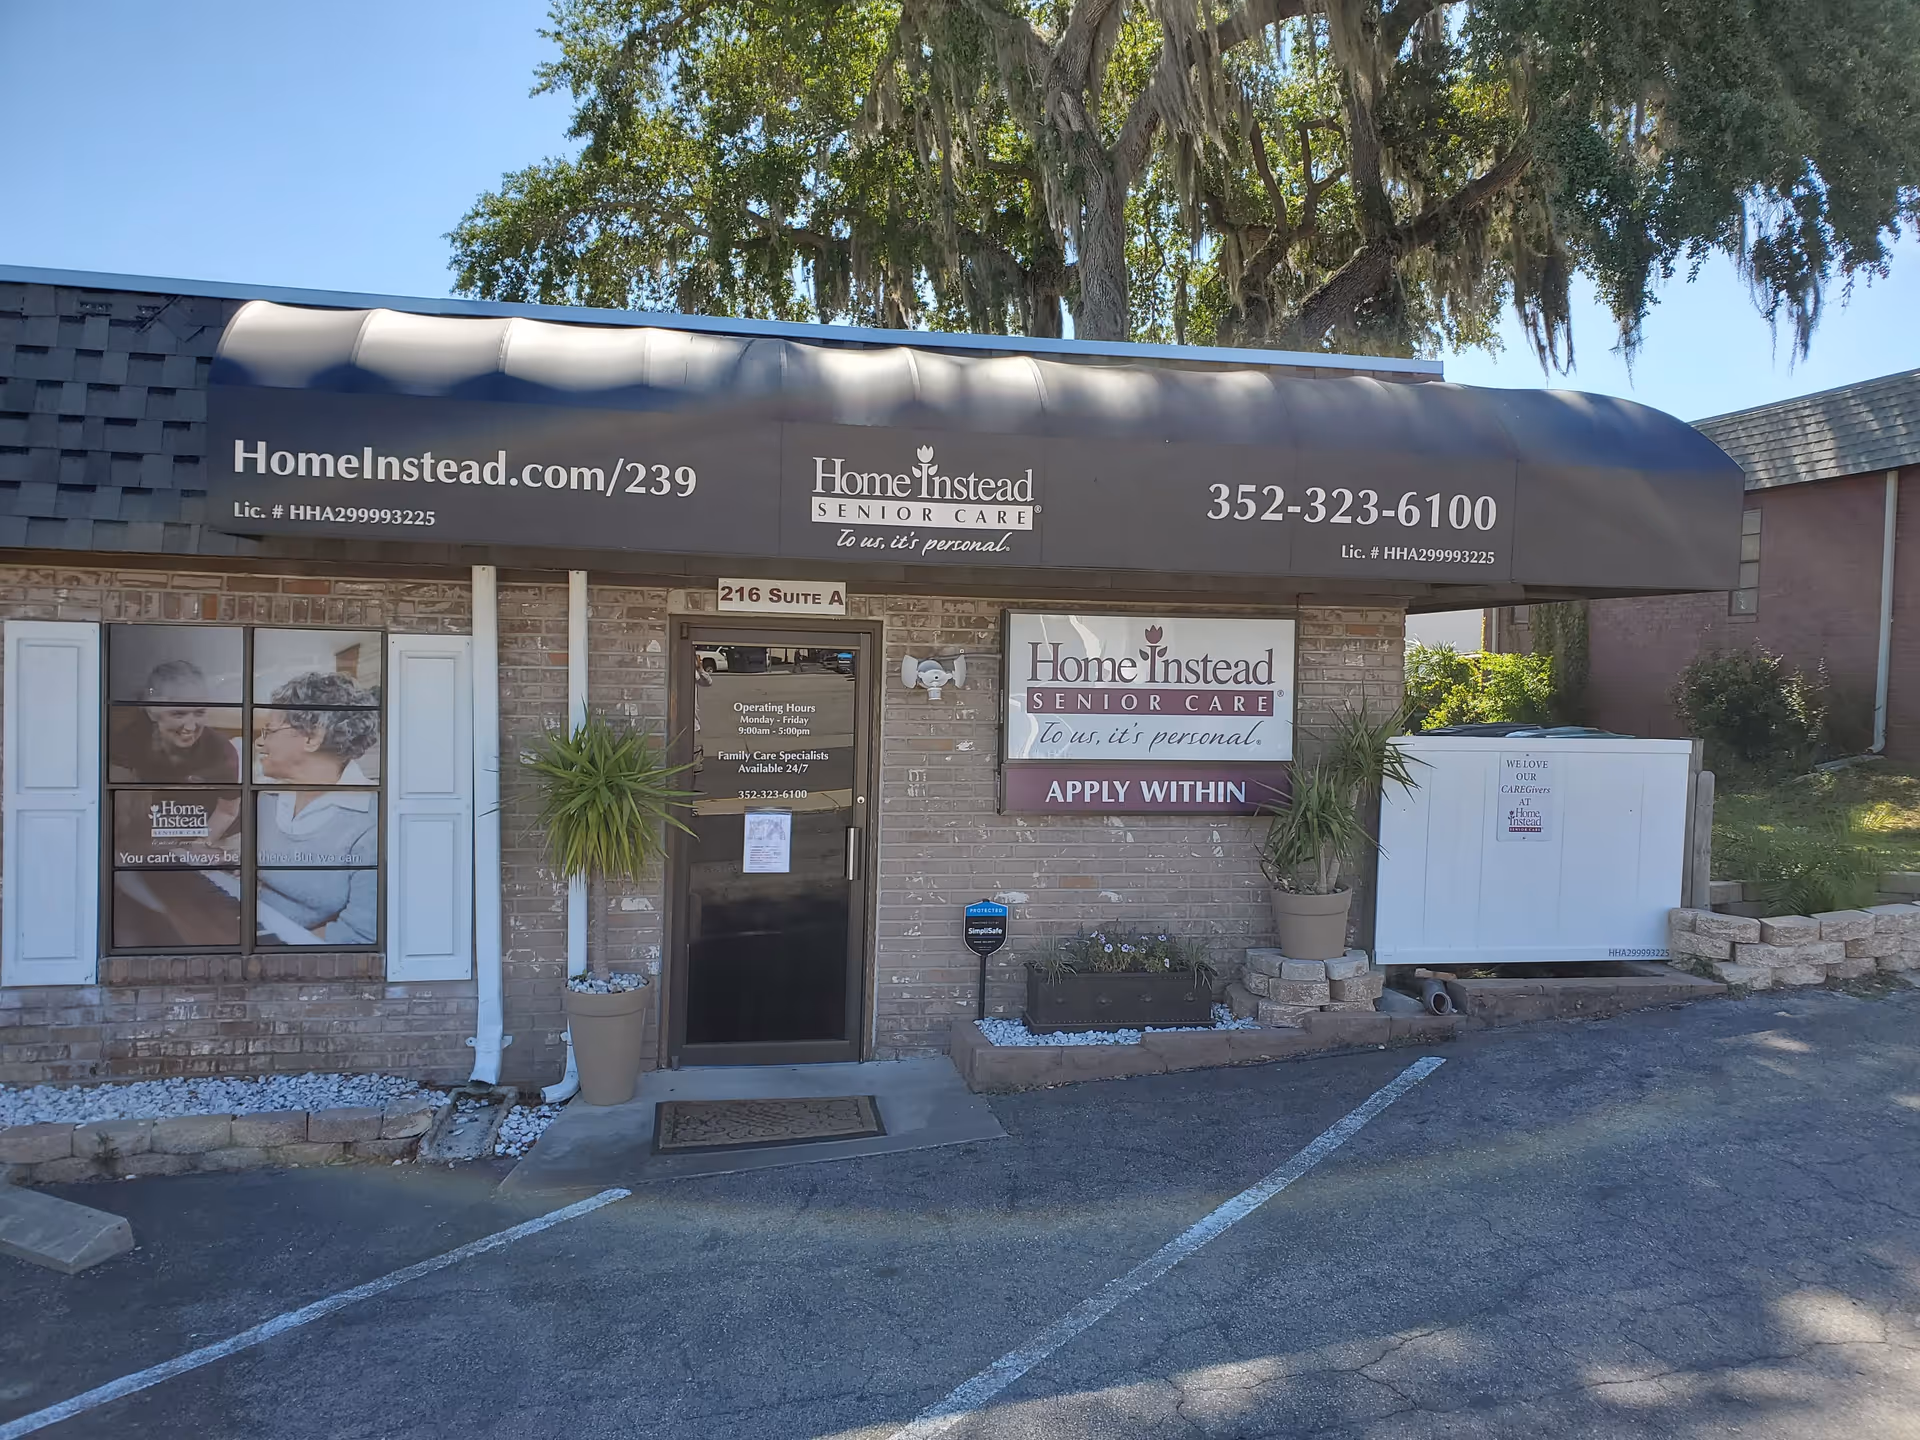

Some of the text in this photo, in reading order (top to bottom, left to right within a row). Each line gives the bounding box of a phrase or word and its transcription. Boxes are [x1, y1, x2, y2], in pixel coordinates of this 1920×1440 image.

[234, 439, 697, 498] HomeInstead.com/239
[812, 456, 1035, 502] Home Instead
[234, 502, 436, 527] Lic. # HHA299993225
[817, 502, 1026, 525] SENIOR CARE
[1206, 483, 1497, 531] 352-323-6100
[836, 529, 856, 548] To
[860, 535, 886, 550] us,
[890, 531, 918, 551] it's
[1341, 544, 1495, 565] Lic. # HHA299993225
[720, 585, 844, 606] 216 SUITE A
[1027, 641, 1276, 686] Home Instead
[733, 702, 816, 715] Operating Hours
[1033, 692, 1268, 712] SENIOR CARE
[740, 715, 775, 725] Monday
[782, 715, 809, 726] Friday
[738, 726, 771, 735] 9:00am
[778, 727, 810, 737] 5:00pm
[1040, 721, 1063, 744] To
[1070, 730, 1100, 745] us,
[1108, 722, 1144, 745] it's
[718, 750, 829, 762] Family Care Specialists
[738, 763, 809, 774] Available 24/7
[1506, 759, 1548, 769] WE LOVE
[1516, 772, 1537, 781] OUR
[738, 789, 808, 799] 352-323-6100
[1045, 780, 1246, 803] APPLY WITHIN
[1501, 784, 1550, 794] CAREGivers
[161, 800, 204, 815] Home
[1518, 797, 1531, 806] AT
[152, 812, 208, 828] Instead
[1515, 807, 1540, 818] Home
[1509, 815, 1542, 827] Instead
[120, 852, 143, 863] You
[147, 851, 176, 863] can't
[180, 851, 220, 866] always
[223, 850, 239, 862] be
[294, 851, 313, 862] But
[318, 853, 335, 862] we
[968, 927, 1003, 935] SimpliSafe
[1608, 948, 1670, 957] HHA299993225
